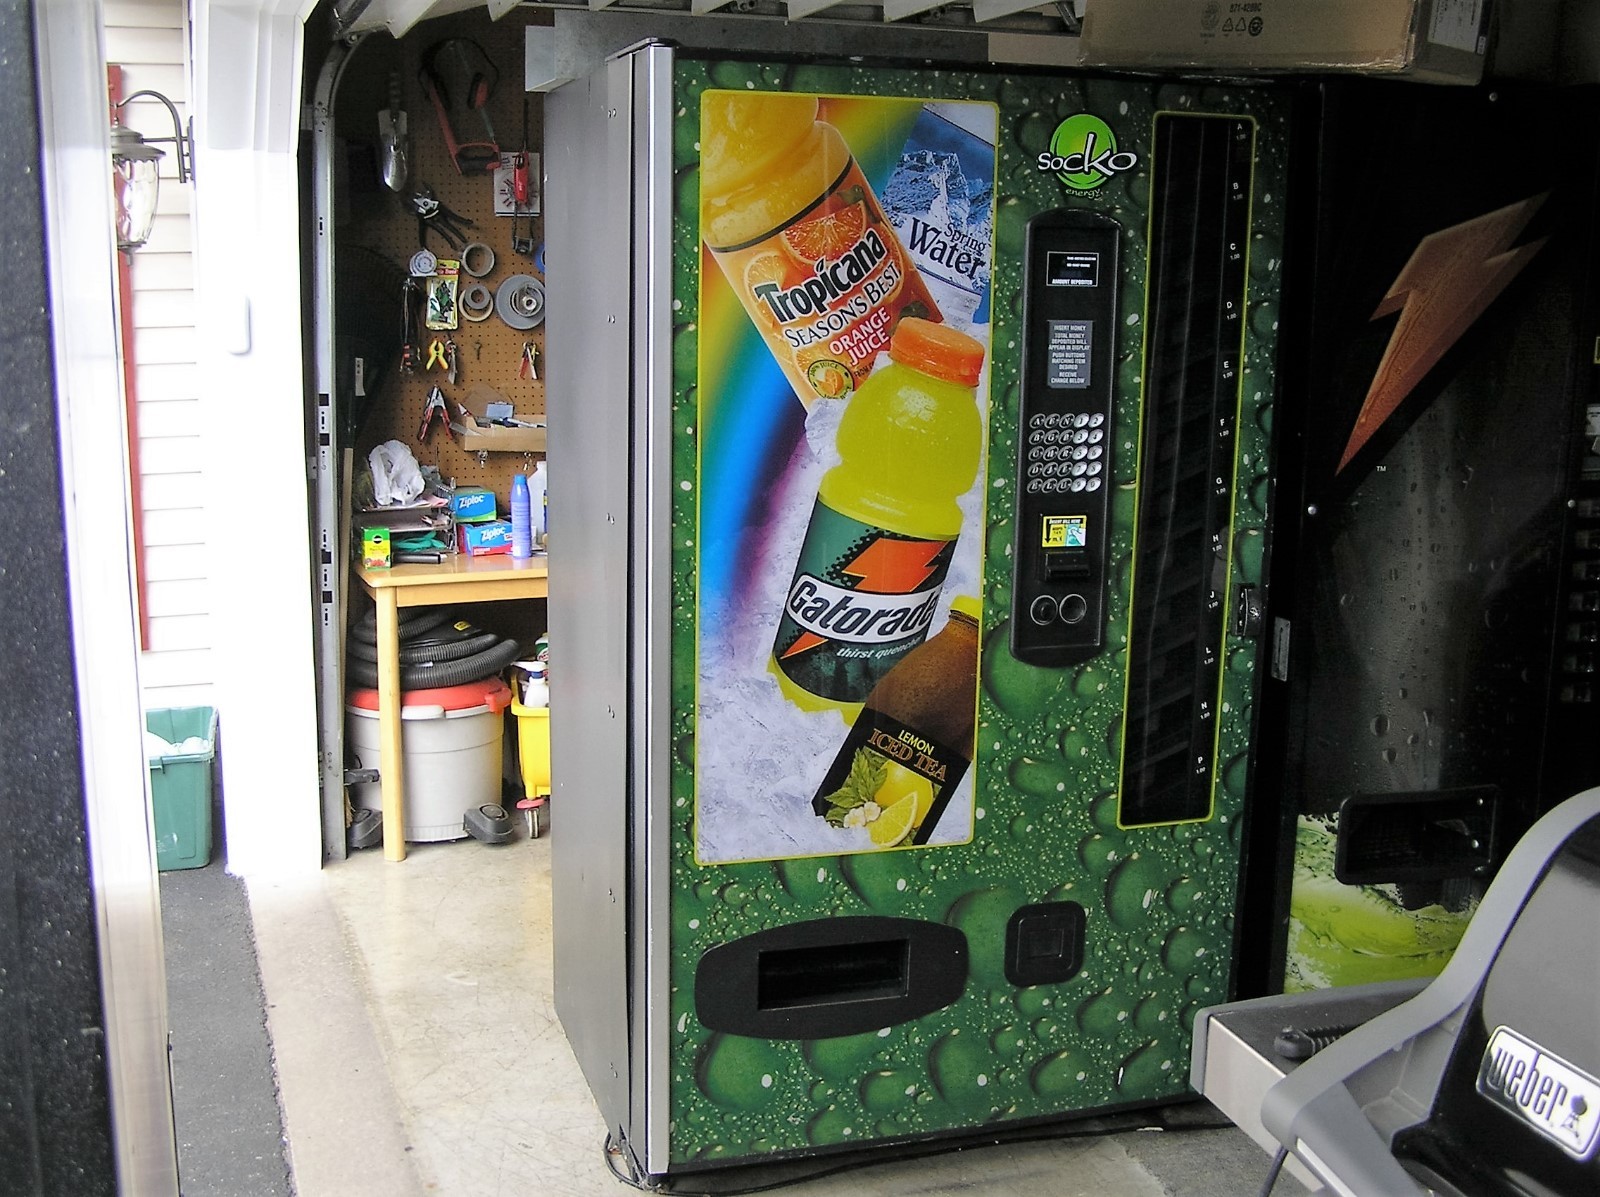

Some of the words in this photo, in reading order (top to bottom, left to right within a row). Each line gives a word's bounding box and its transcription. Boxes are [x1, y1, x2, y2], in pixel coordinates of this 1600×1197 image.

[1066, 189, 1101, 199] energy
[909, 217, 987, 280] Water
[944, 222, 987, 256] Spring
[754, 228, 888, 323] Tropicana
[863, 261, 901, 304] BEST
[829, 307, 891, 356] ORANGE
[848, 329, 891, 366] JUICE
[1219, 419, 1224, 427] F
[459, 494, 485, 508] Ziploc
[481, 527, 506, 541] Ziploc
[790, 580, 941, 637] Gatorade
[836, 647, 875, 659] thirst
[867, 728, 914, 761] ICED
[913, 751, 947, 781] TEA
[898, 730, 935, 756] LEMON
[1486, 1047, 1568, 1121] weber
